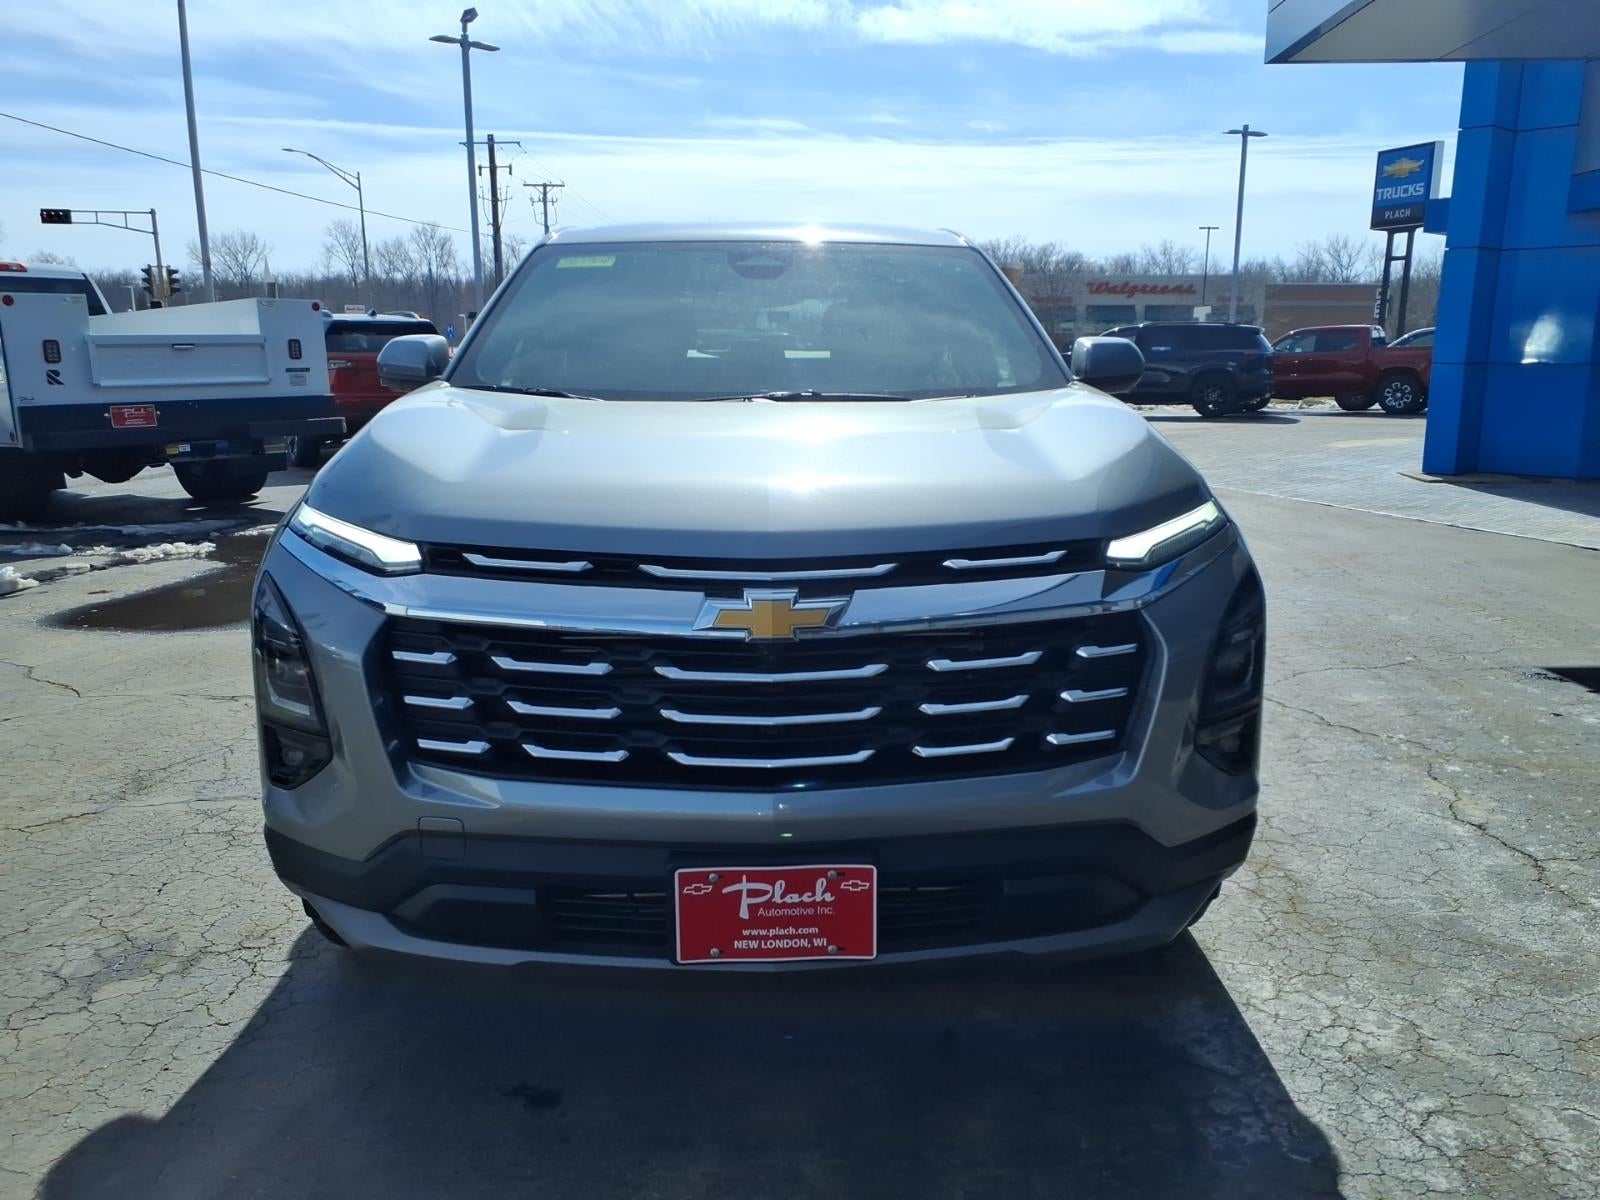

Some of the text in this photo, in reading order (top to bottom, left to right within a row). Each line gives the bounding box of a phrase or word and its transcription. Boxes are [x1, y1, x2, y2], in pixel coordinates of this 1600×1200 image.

[1376, 183, 1424, 200] TRUCKS
[1385, 208, 1411, 219] PLACH
[1086, 281, 1197, 299] Walgreens
[722, 874, 836, 920] Plach
[757, 905, 836, 917] Automotive Inc.
[742, 926, 819, 937] www.plach.com
[734, 937, 828, 949] NEW LONDON, WI
